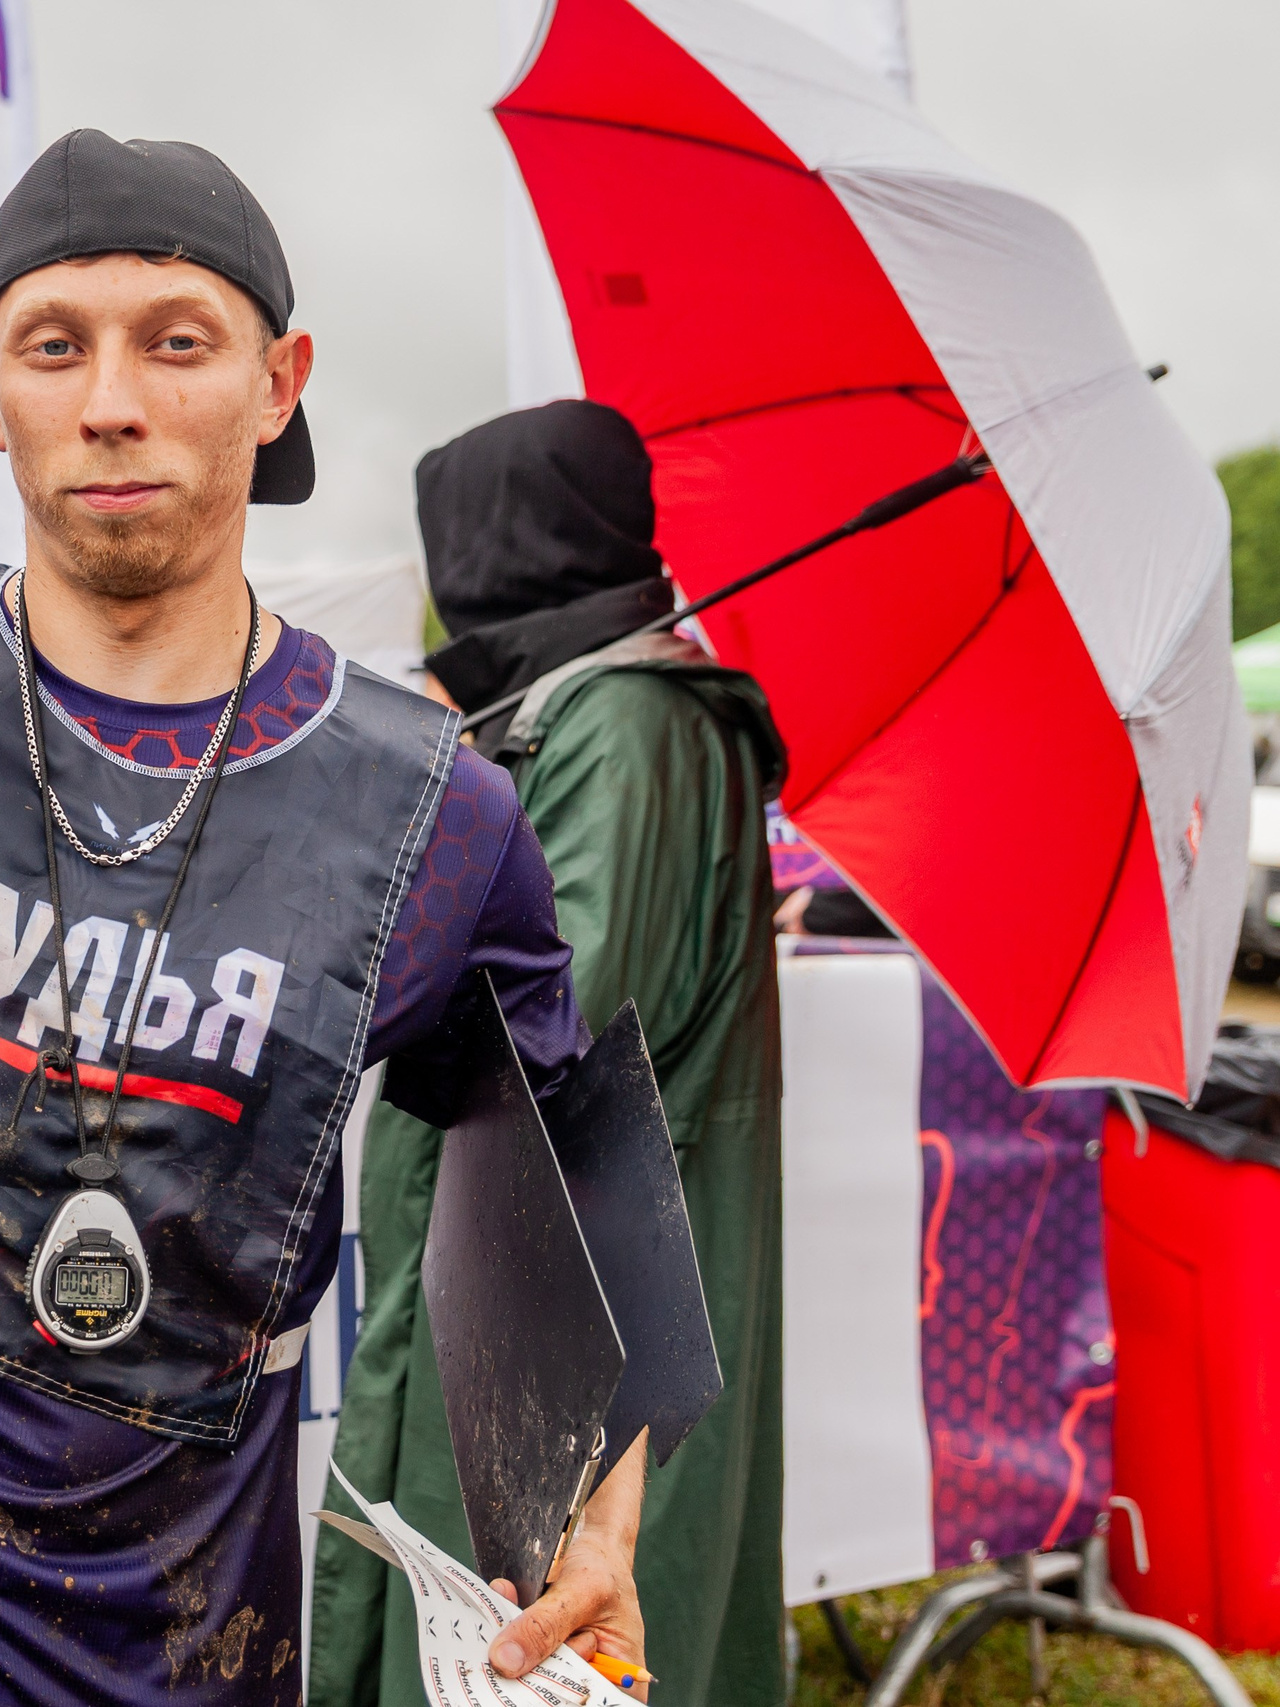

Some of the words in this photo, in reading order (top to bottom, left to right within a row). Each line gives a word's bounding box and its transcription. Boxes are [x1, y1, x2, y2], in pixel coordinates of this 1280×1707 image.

[75, 1309, 108, 1317] INGAME
[446, 1565, 475, 1587] ГОНКА
[476, 1588, 504, 1622] ГЕРОЕВ
[432, 1657, 445, 1694] ГОНКА
[458, 1660, 473, 1695] ГОНКА
[484, 1663, 503, 1694] ГОНКА
[557, 1675, 590, 1695] ГЕРОЕВ
[531, 1683, 561, 1706] ЕРОЕВ
